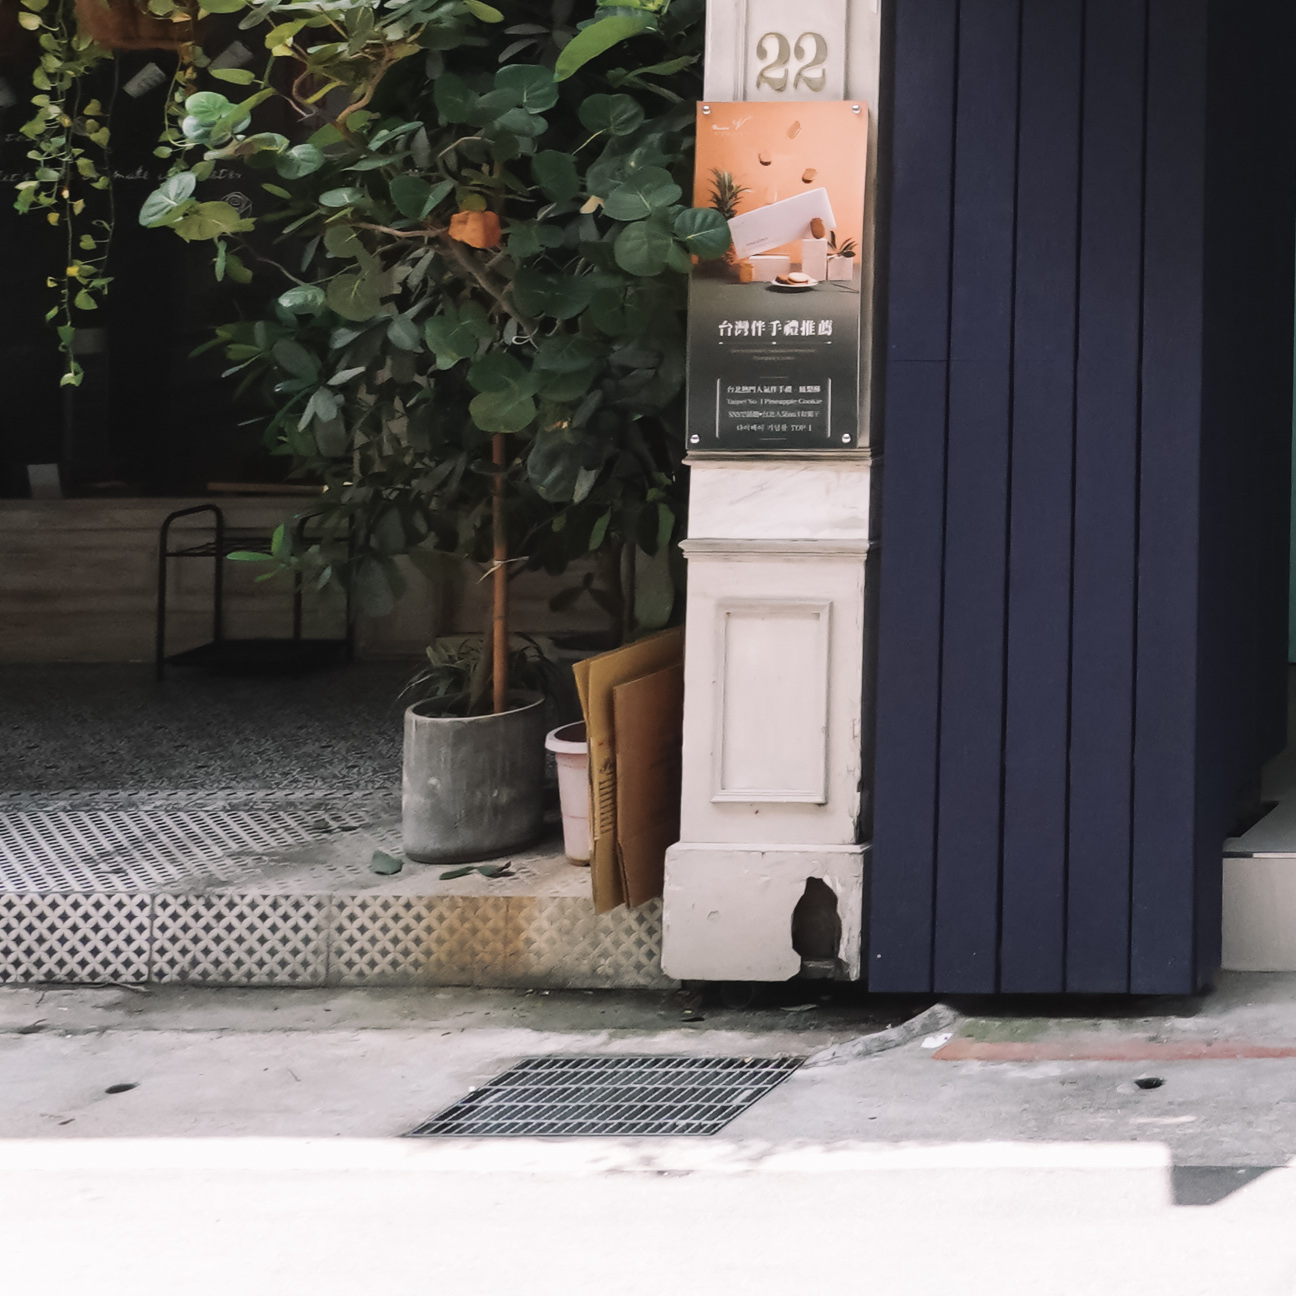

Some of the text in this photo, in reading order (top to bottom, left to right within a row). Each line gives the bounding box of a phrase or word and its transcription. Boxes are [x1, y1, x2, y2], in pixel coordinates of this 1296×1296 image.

[756, 32, 829, 92] 22
[718, 319, 833, 337] 台灣伴手禮推薦
[790, 424, 806, 432] TOP
